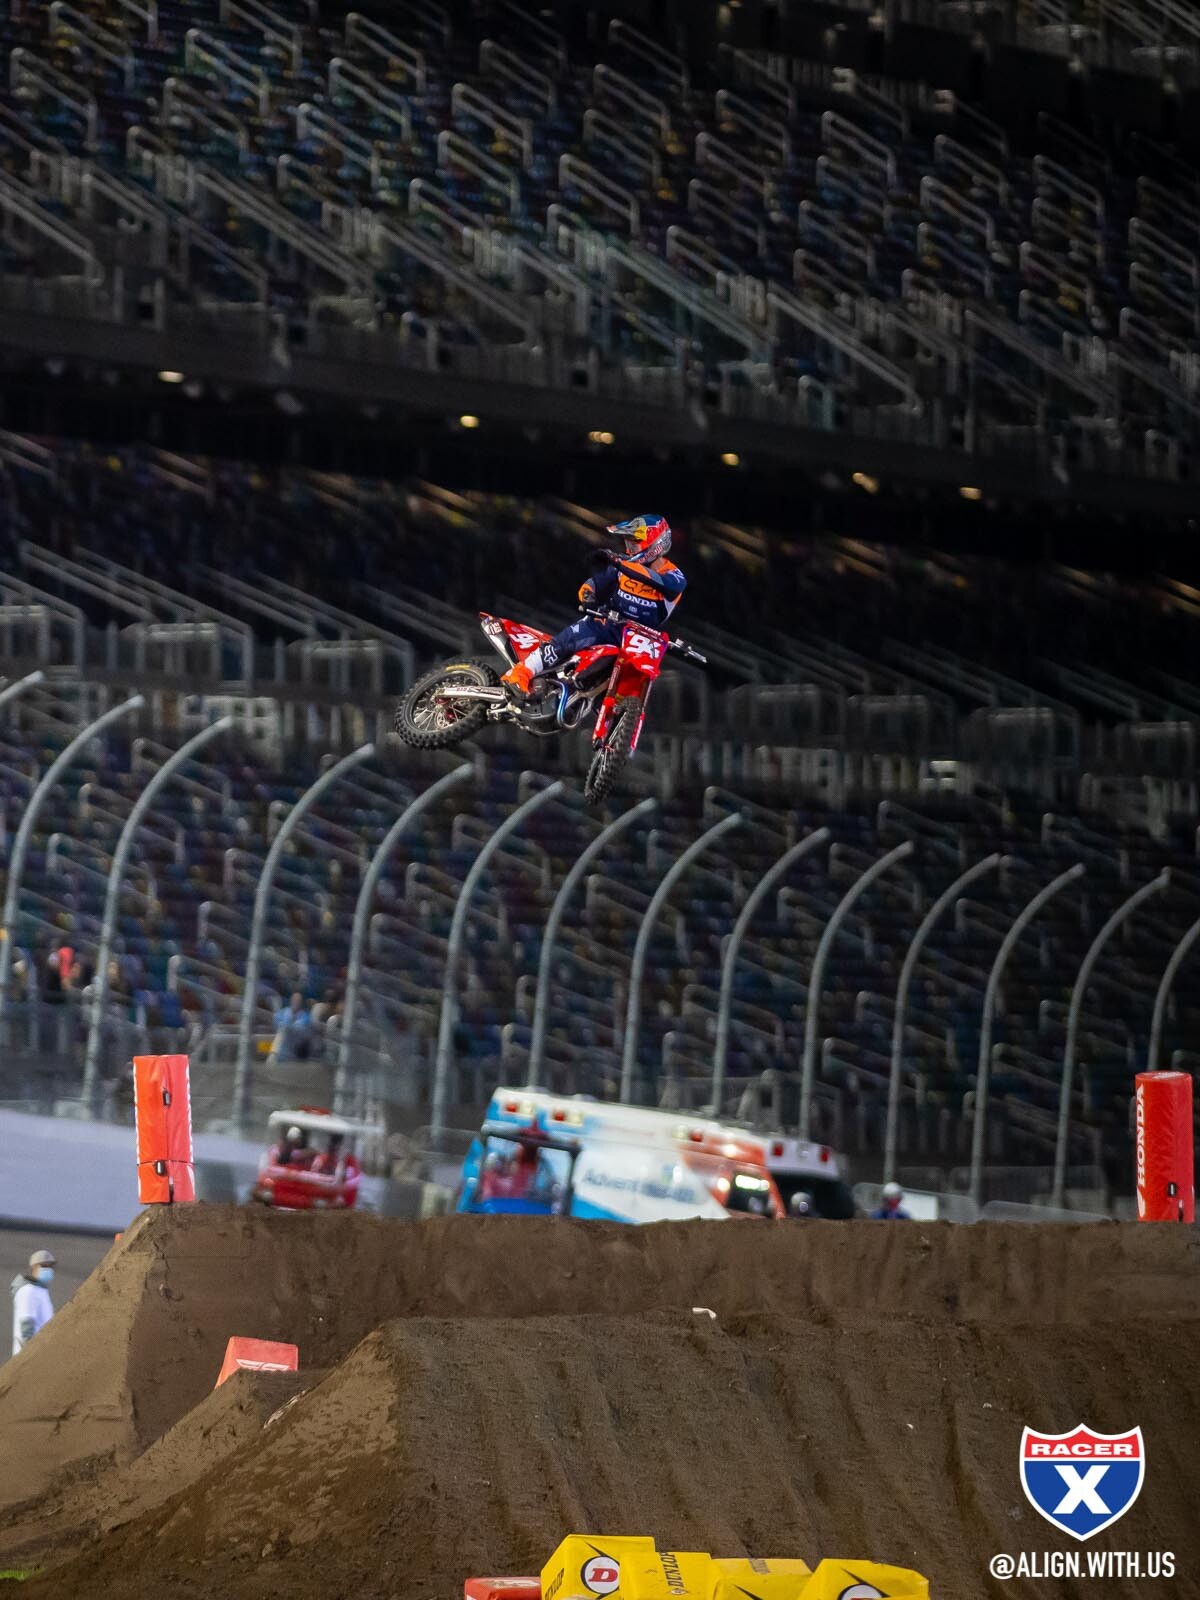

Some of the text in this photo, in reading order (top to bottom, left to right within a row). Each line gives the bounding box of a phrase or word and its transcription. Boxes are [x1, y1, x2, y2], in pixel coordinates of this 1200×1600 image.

[617, 588, 658, 608] HONDA
[625, 633, 662, 660] 94
[1136, 1084, 1146, 1187] HONDA
[588, 1567, 619, 1583] D
